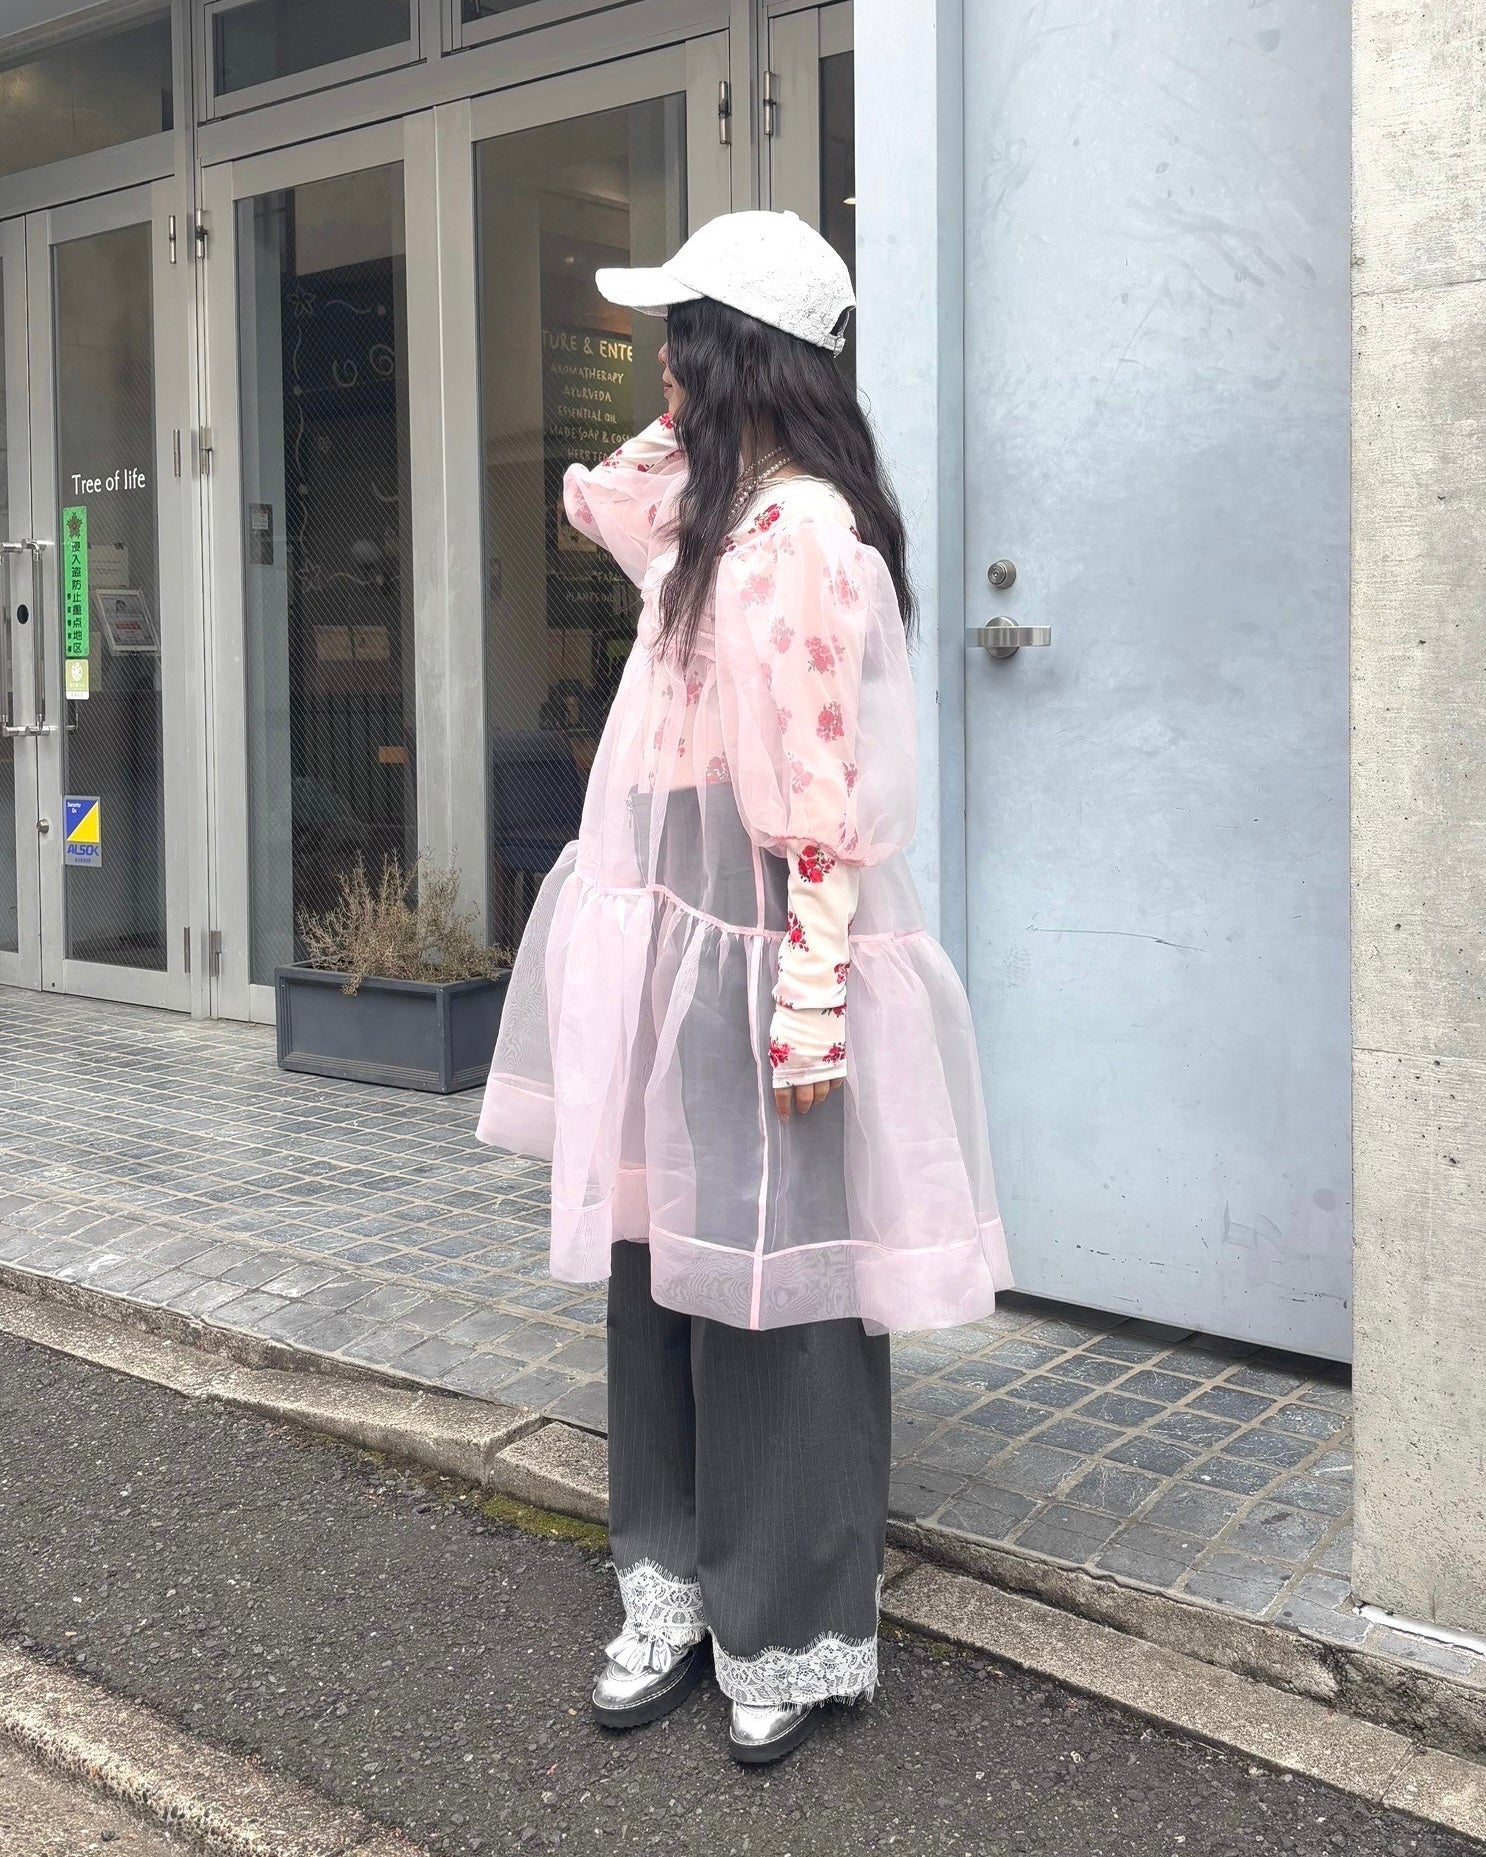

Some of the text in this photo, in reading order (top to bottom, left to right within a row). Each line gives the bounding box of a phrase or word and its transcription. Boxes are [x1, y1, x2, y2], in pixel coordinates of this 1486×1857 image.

[583, 336, 594, 356] &
[551, 363, 624, 384] AROMATHERAPY
[563, 384, 612, 402] AYURVEDA
[558, 405, 617, 424] ESSENTIAL OIL
[602, 431, 609, 443] &
[567, 448, 591, 460] HERB
[71, 467, 146, 494] Tree of life
[67, 844, 99, 856] ALSOK
